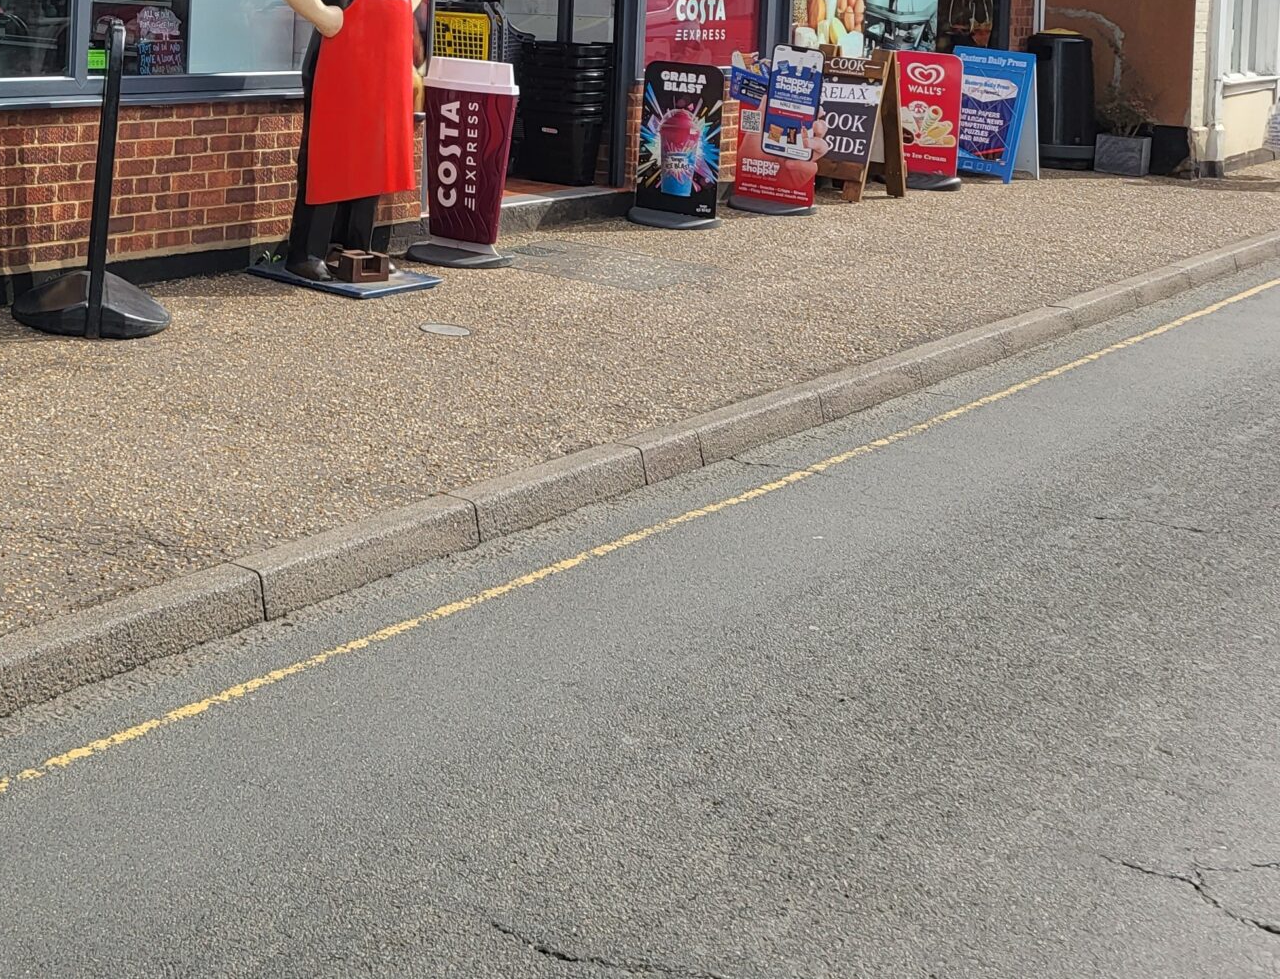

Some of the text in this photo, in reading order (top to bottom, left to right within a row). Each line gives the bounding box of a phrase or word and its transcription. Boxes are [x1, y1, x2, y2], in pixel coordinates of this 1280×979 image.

[683, 29, 726, 41] EXPRESS
[830, 57, 866, 71] COOK
[960, 53, 1027, 68] Eastern Daily Press
[663, 81, 703, 94] BLAST
[776, 75, 809, 88] snappy
[775, 82, 813, 95] shopper
[820, 85, 869, 101] RELAX
[908, 84, 942, 96] WALL'S
[825, 111, 867, 133] OOK
[960, 120, 999, 131] OMPETITIONS
[967, 115, 1004, 126] LOCAL NEWS
[466, 102, 479, 194] EXPRESS
[825, 134, 867, 156] SIDE
[437, 100, 461, 207] COSTA
[924, 153, 947, 162] Cream
[741, 163, 778, 176] shopper
[742, 157, 773, 170] snappy
